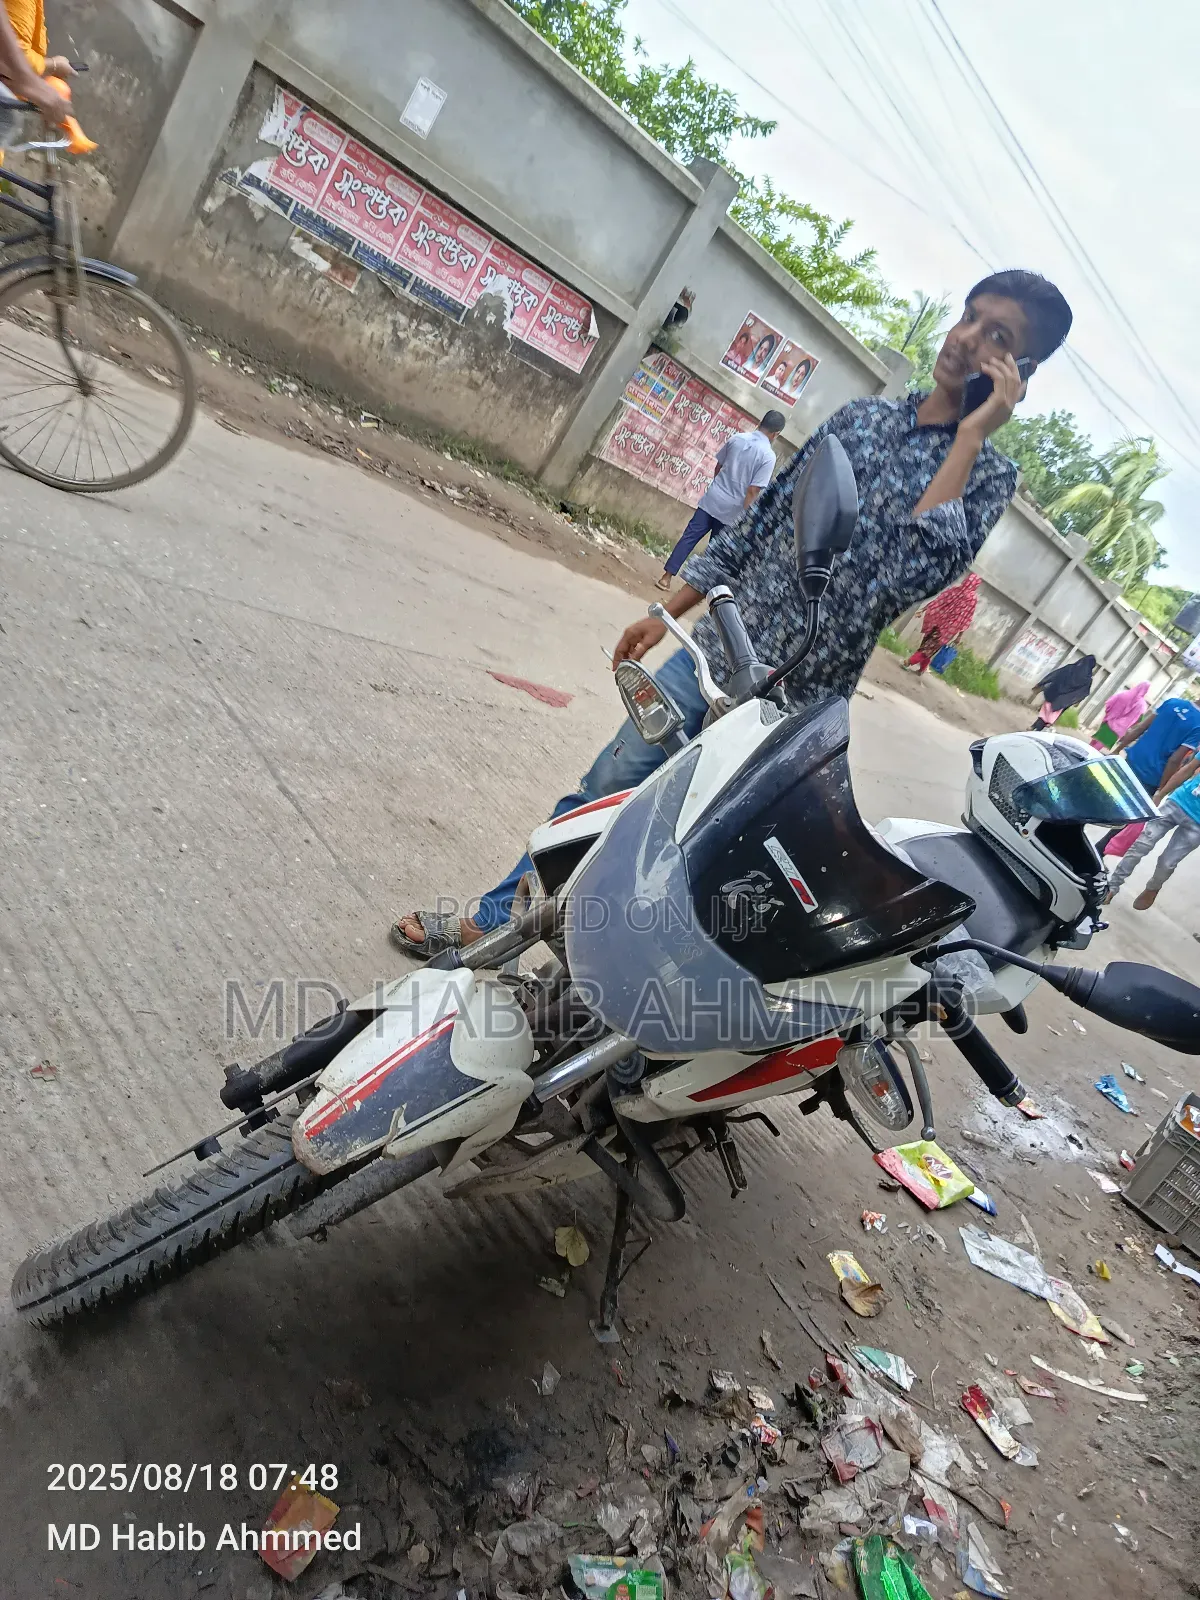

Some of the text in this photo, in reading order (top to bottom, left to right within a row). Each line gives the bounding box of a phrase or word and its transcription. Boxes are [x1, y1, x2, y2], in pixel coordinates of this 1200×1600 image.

[333, 167, 409, 228] সংশপ্তক
[410, 219, 478, 273] সংশপ্তক
[674, 393, 712, 427] সংশপ্তক
[614, 425, 656, 457] সংশপ্তক
[654, 449, 692, 479] সংশপ্তক
